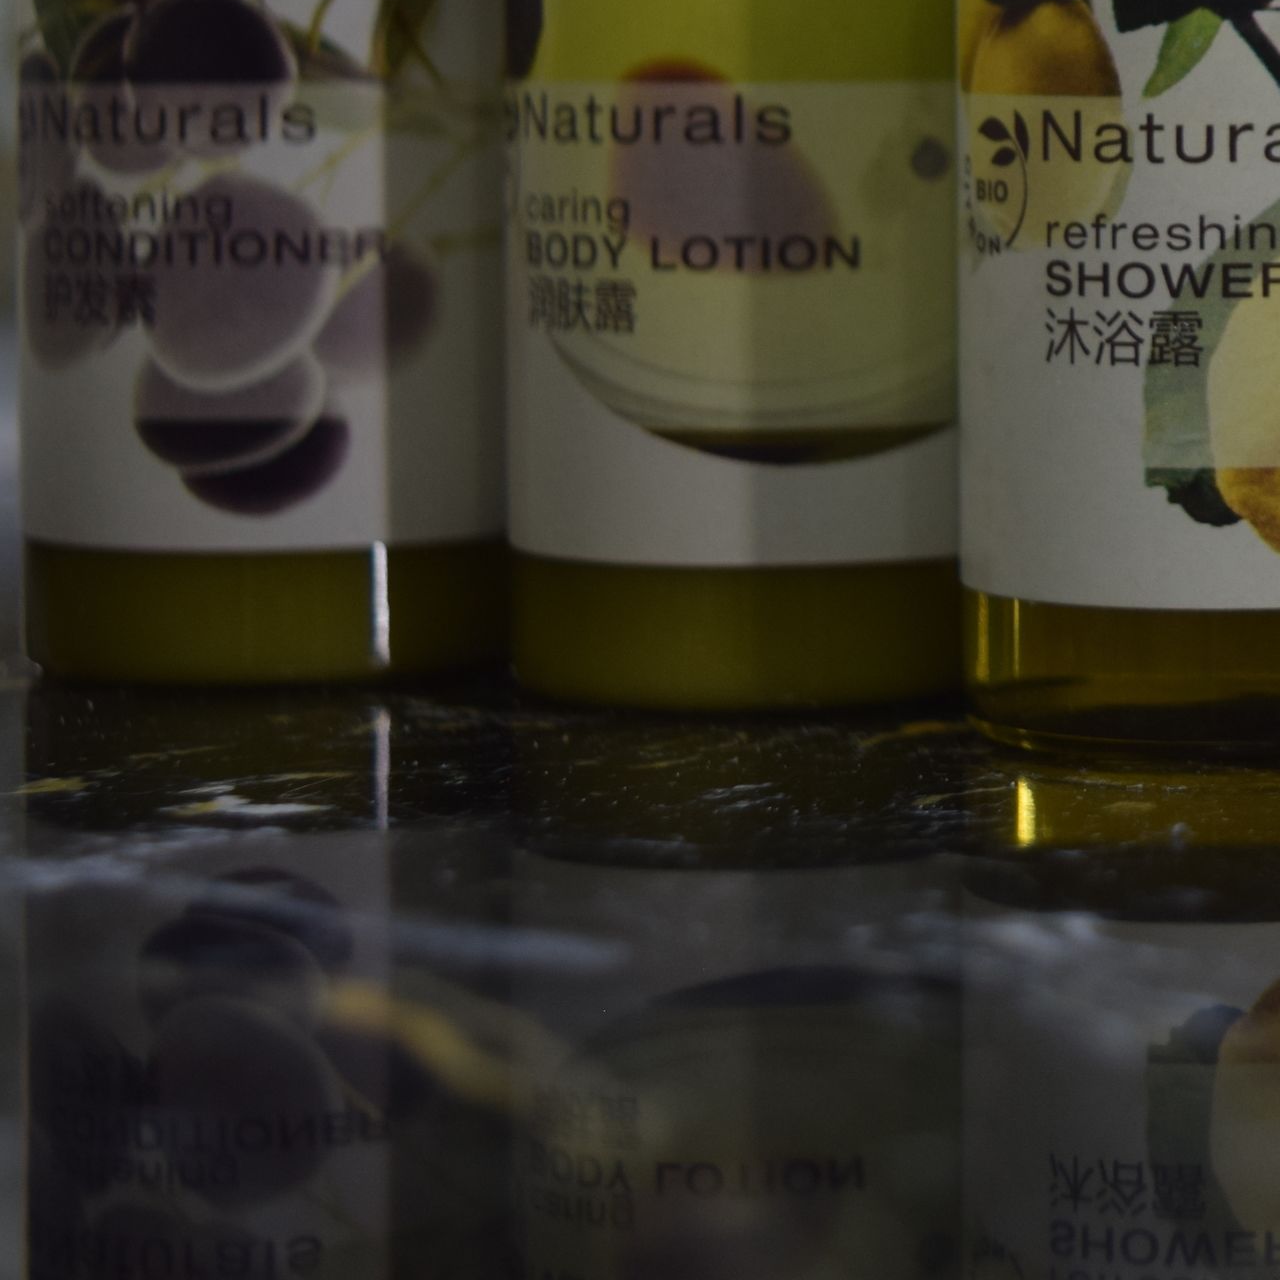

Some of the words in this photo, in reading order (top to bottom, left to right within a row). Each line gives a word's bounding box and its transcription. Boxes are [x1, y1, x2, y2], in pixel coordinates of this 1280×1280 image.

[40, 92, 317, 147] Naturals
[523, 91, 793, 148] Naturals
[527, 187, 632, 234] caring
[975, 177, 1009, 204] BIO
[44, 227, 390, 269] CONDITIONER
[527, 229, 629, 270] BODY
[649, 232, 862, 272] LOTION
[1045, 308, 1204, 369] 沐浴露
